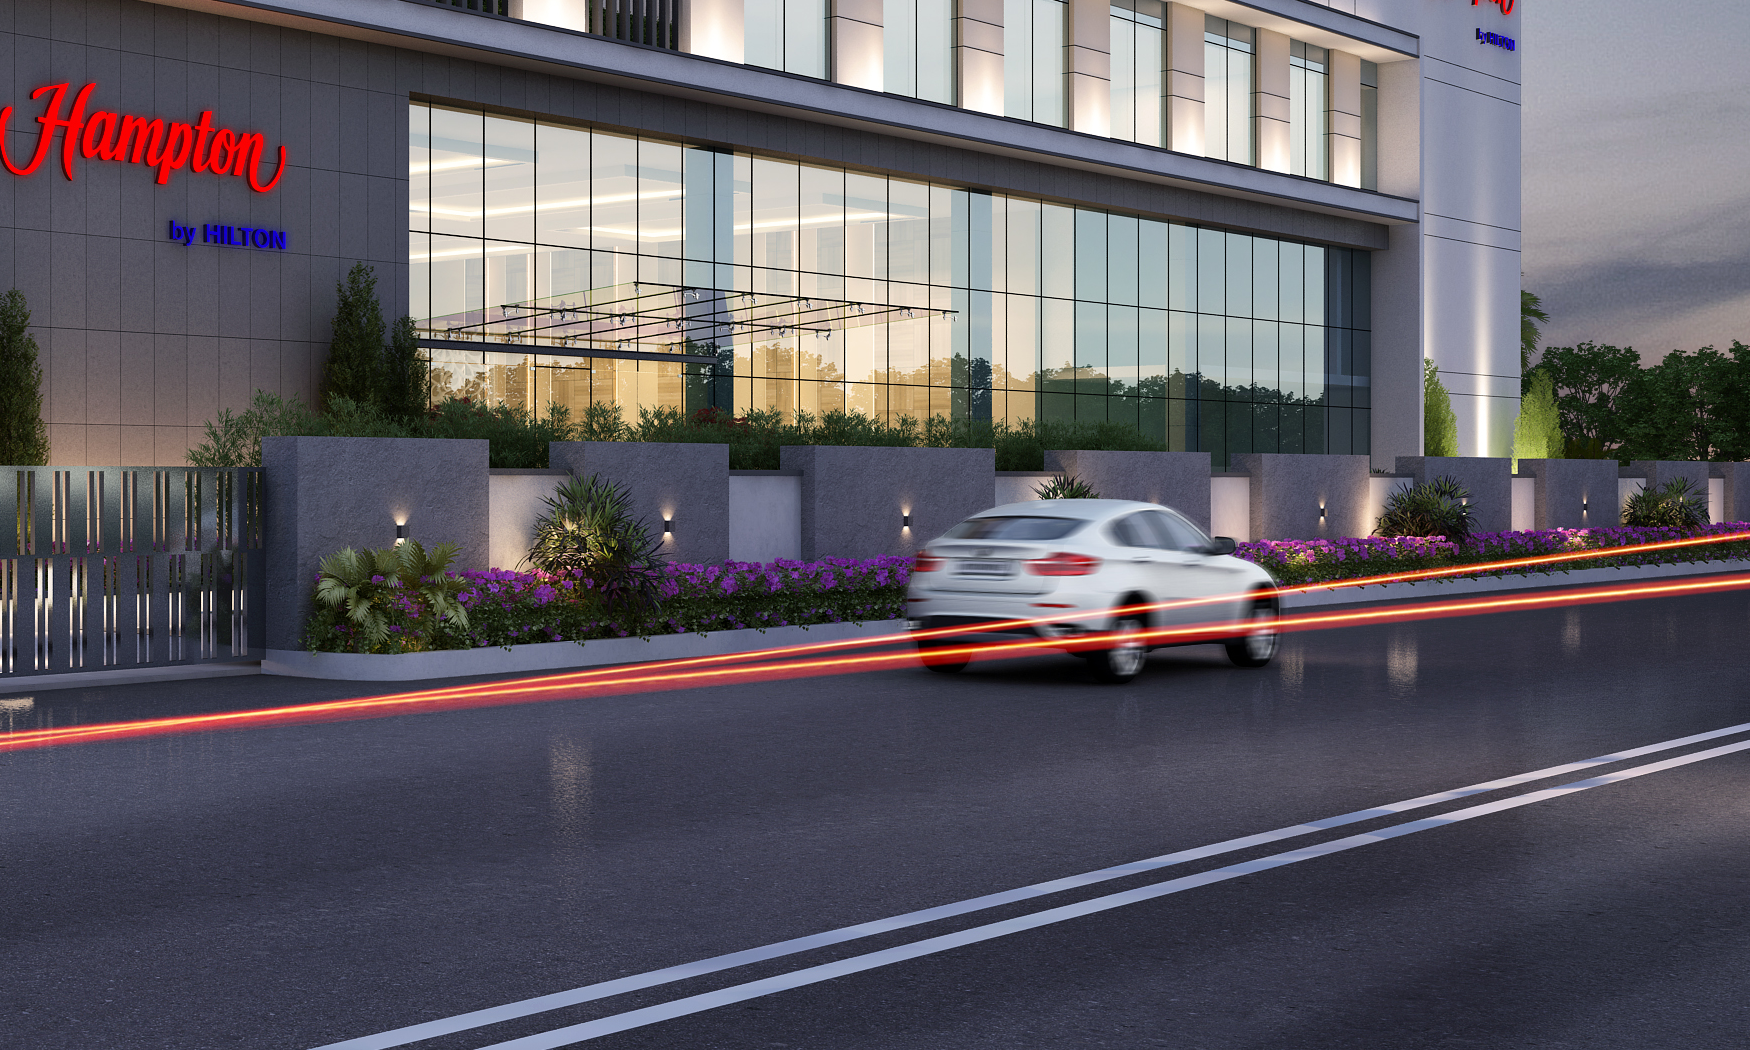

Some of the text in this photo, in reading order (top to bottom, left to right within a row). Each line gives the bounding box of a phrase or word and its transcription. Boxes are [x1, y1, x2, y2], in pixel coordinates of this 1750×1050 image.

[1476, 27, 1516, 52] by HILTON
[169, 220, 287, 250] by HILTON
